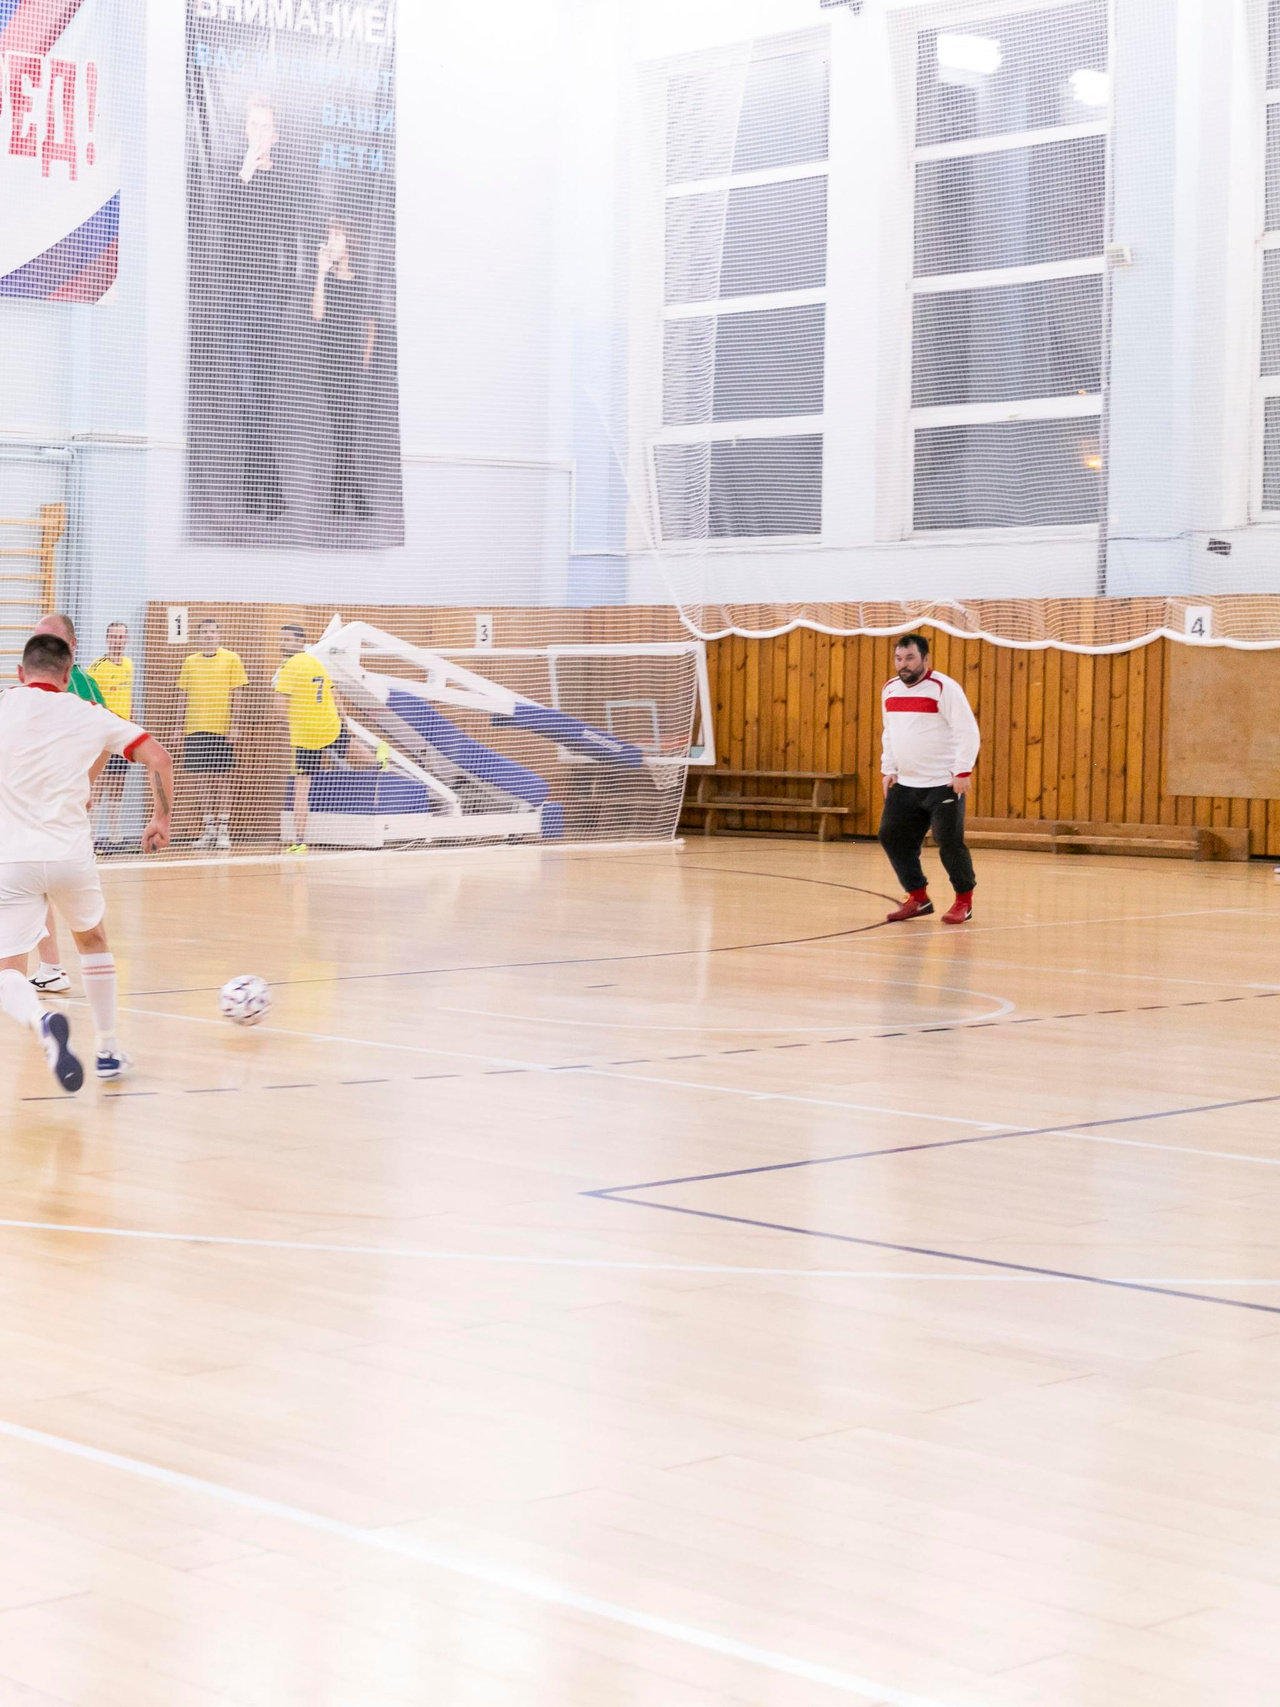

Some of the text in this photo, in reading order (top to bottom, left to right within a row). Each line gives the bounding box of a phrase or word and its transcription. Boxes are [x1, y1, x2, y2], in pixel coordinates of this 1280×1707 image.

[174, 613, 182, 636] 1
[480, 624, 489, 642] 3
[1190, 616, 1206, 637] 4
[311, 675, 325, 704] 7
